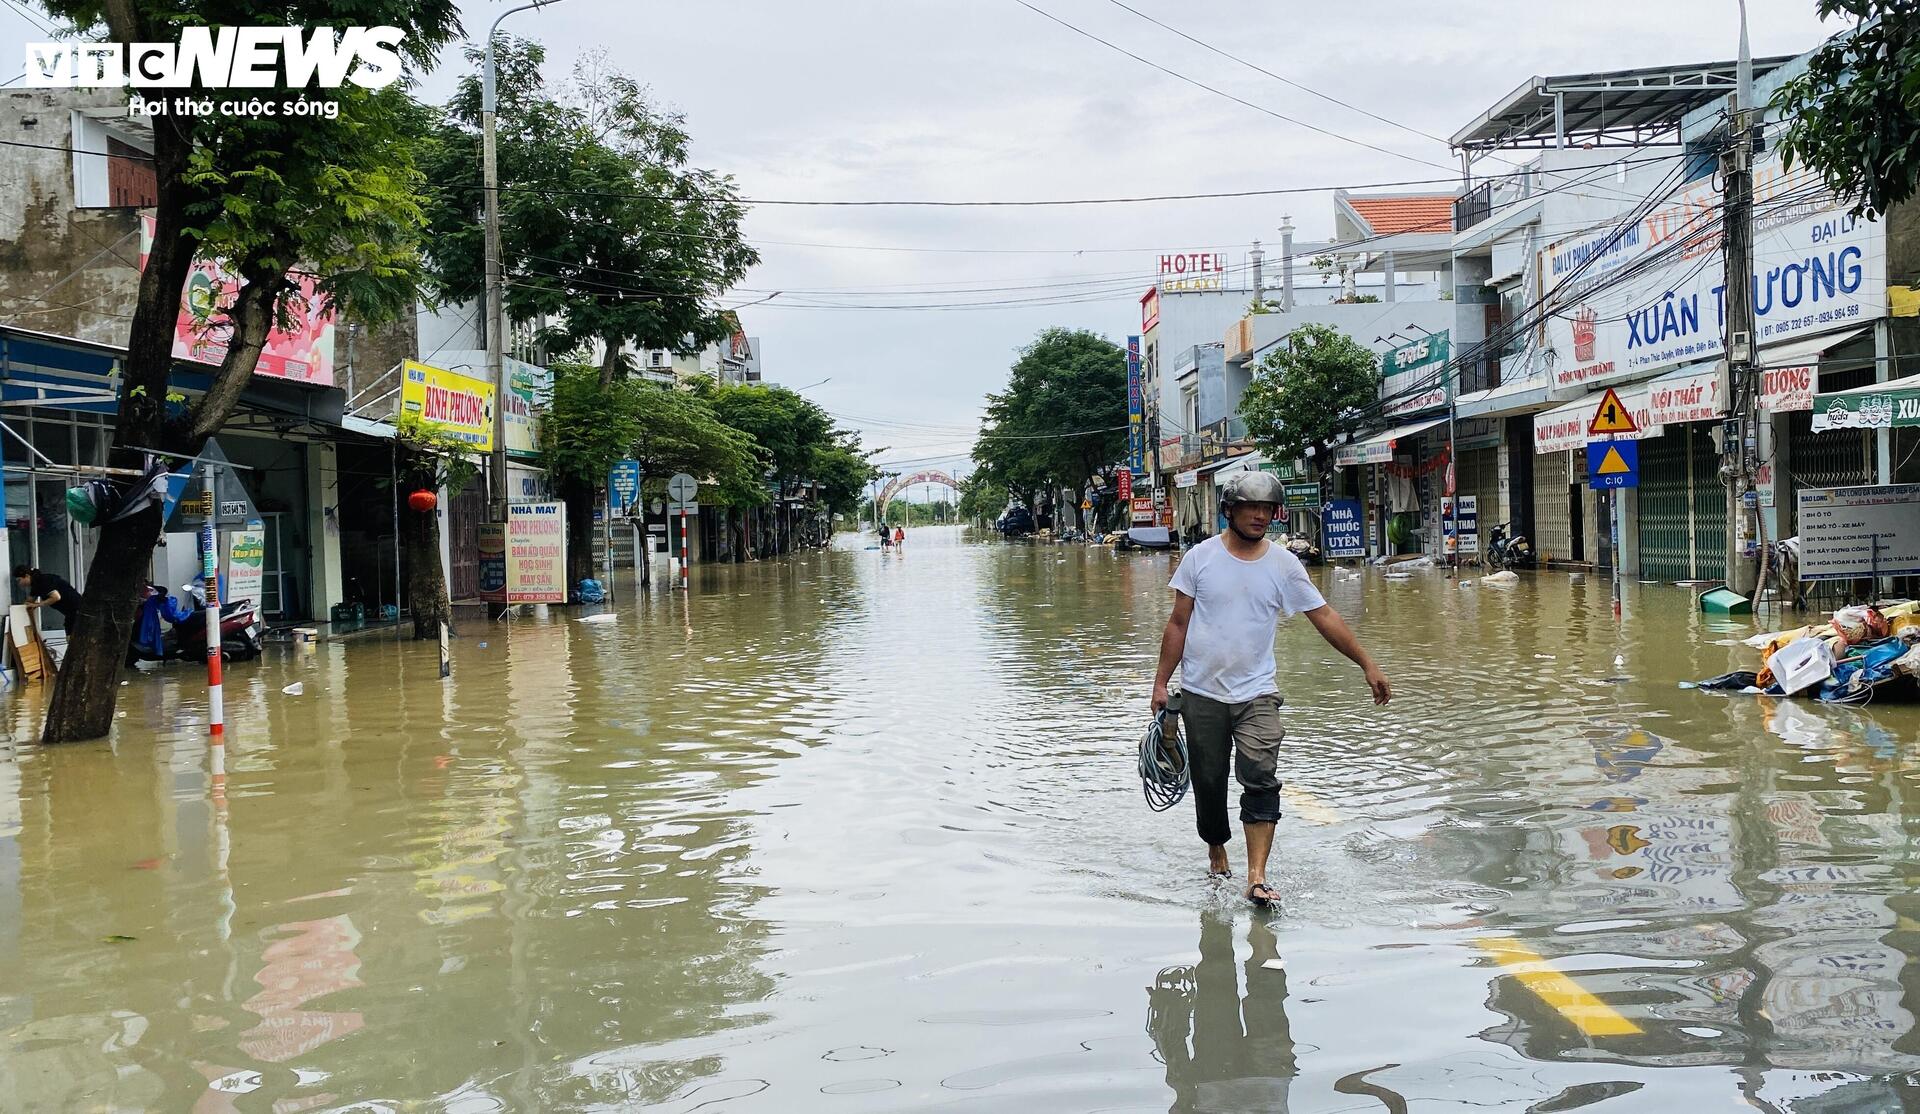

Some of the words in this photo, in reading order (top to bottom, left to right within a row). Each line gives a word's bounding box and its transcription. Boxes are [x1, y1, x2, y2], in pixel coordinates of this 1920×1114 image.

[1811, 220, 1836, 244] ĐẠI
[1161, 253, 1223, 273] HOTEL
[1165, 278, 1220, 290] GALAXY
[1627, 291, 1699, 350] XUÂN
[1712, 246, 1862, 327] TƯƠNG
[1775, 321, 1790, 333] 0905
[1791, 317, 1802, 329] 232
[1803, 314, 1814, 326] 657
[1818, 310, 1834, 323] 0934
[1834, 307, 1846, 320] 964
[1847, 304, 1859, 317] 568
[1130, 342, 1140, 409] GALAXY
[424, 377, 448, 421] BÌNH
[1897, 398, 1920, 419] XU
[535, 506, 557, 515] MAY
[1331, 507, 1353, 520] NHÀ
[1326, 518, 1360, 533] THUỐC
[1328, 533, 1360, 548] UYÊN
